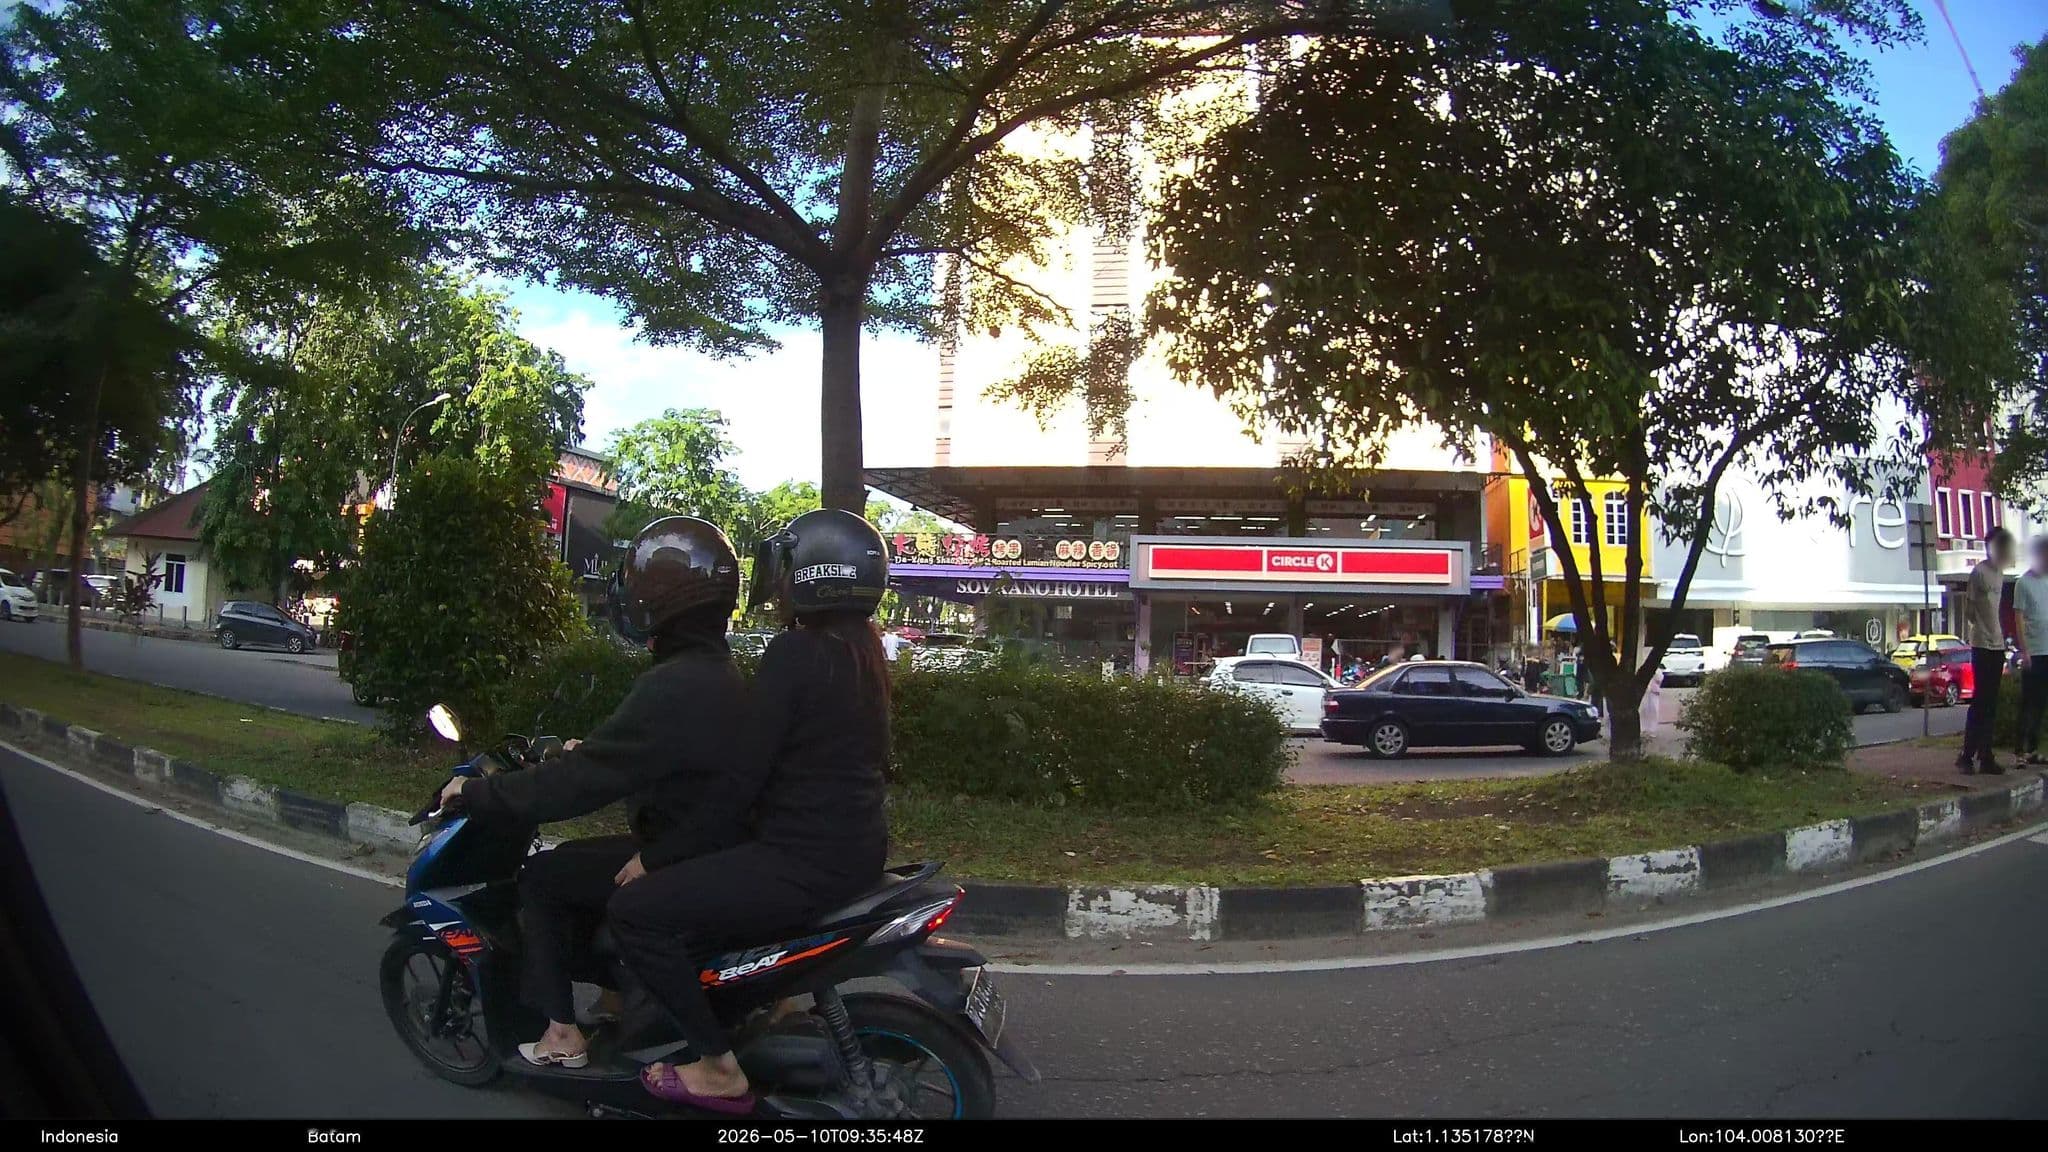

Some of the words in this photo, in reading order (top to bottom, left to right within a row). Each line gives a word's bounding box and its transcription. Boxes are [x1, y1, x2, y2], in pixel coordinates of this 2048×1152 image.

[1271, 555, 1315, 567] CIRCLE
[795, 564, 856, 583] BREAKSIE
[1054, 582, 1118, 597] HOTEL
